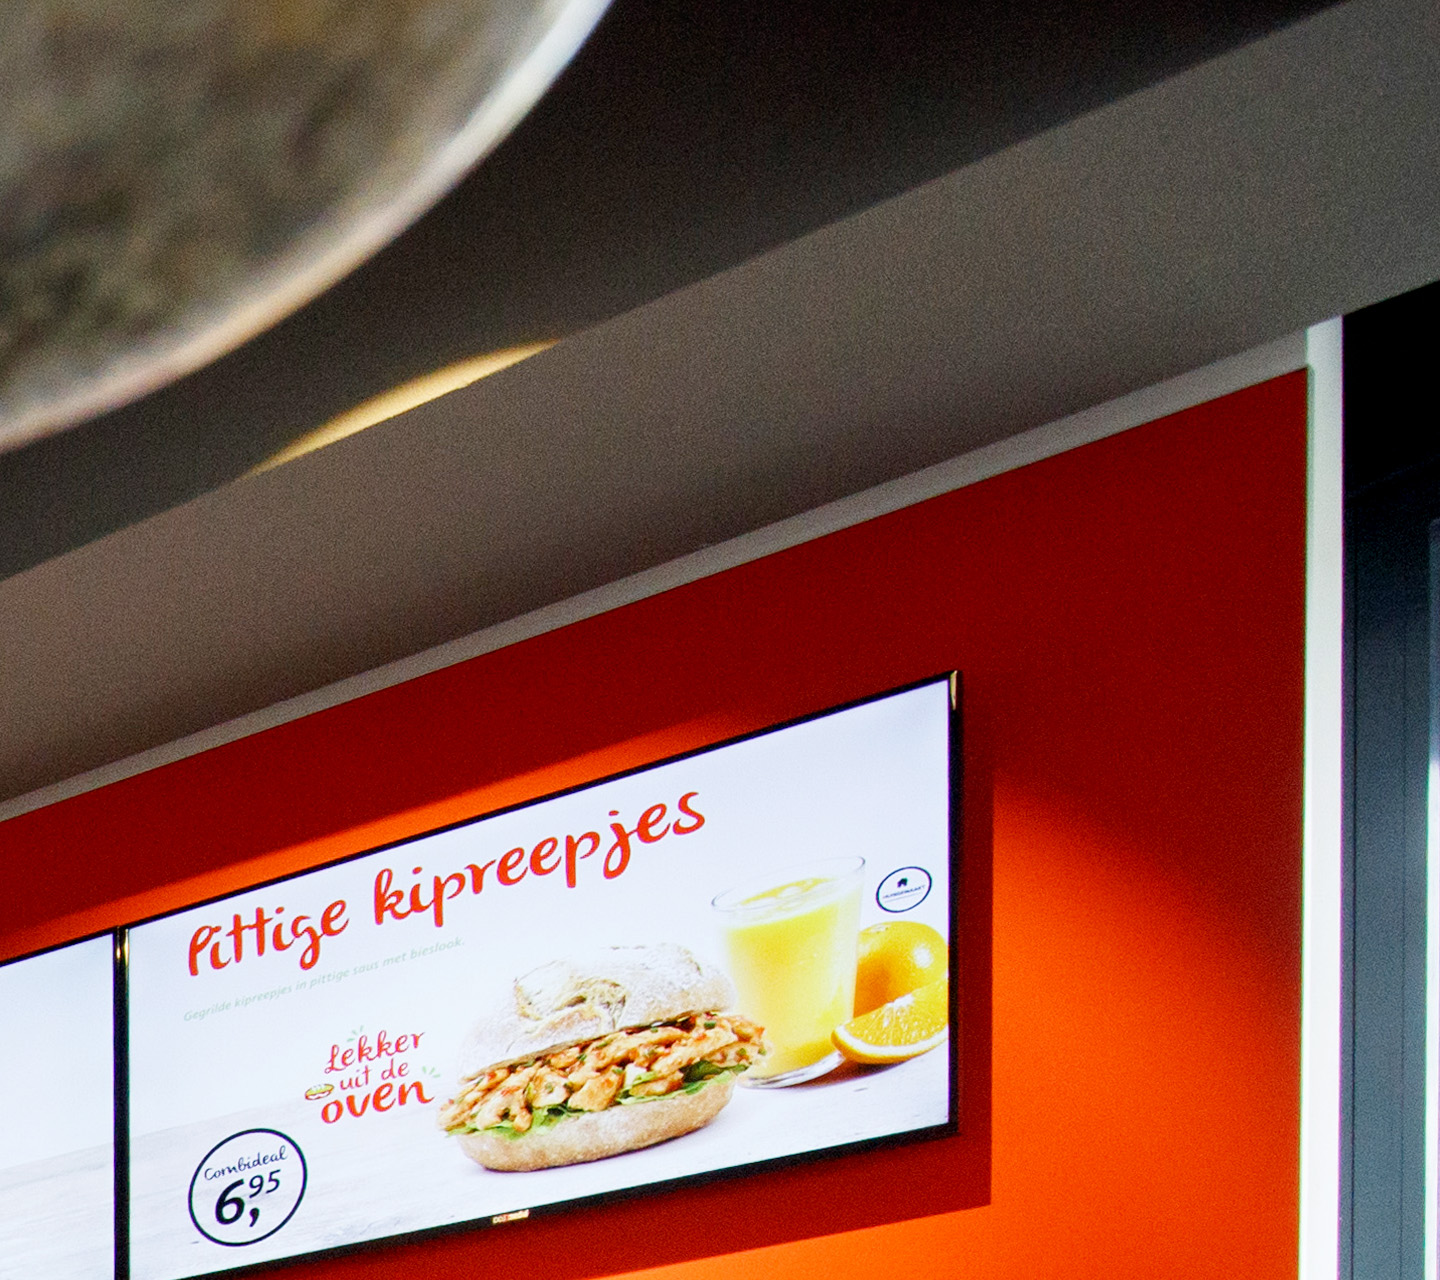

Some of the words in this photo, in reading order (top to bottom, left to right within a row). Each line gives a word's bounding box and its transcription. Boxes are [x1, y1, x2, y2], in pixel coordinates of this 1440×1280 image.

[188, 894, 350, 976] Pittige
[374, 791, 707, 927] kipreepjes
[324, 1029, 425, 1075] Lekker
[340, 1065, 370, 1088] uit
[381, 1058, 410, 1079] de
[321, 1071, 434, 1124] oven
[203, 1146, 288, 1183] Combideal
